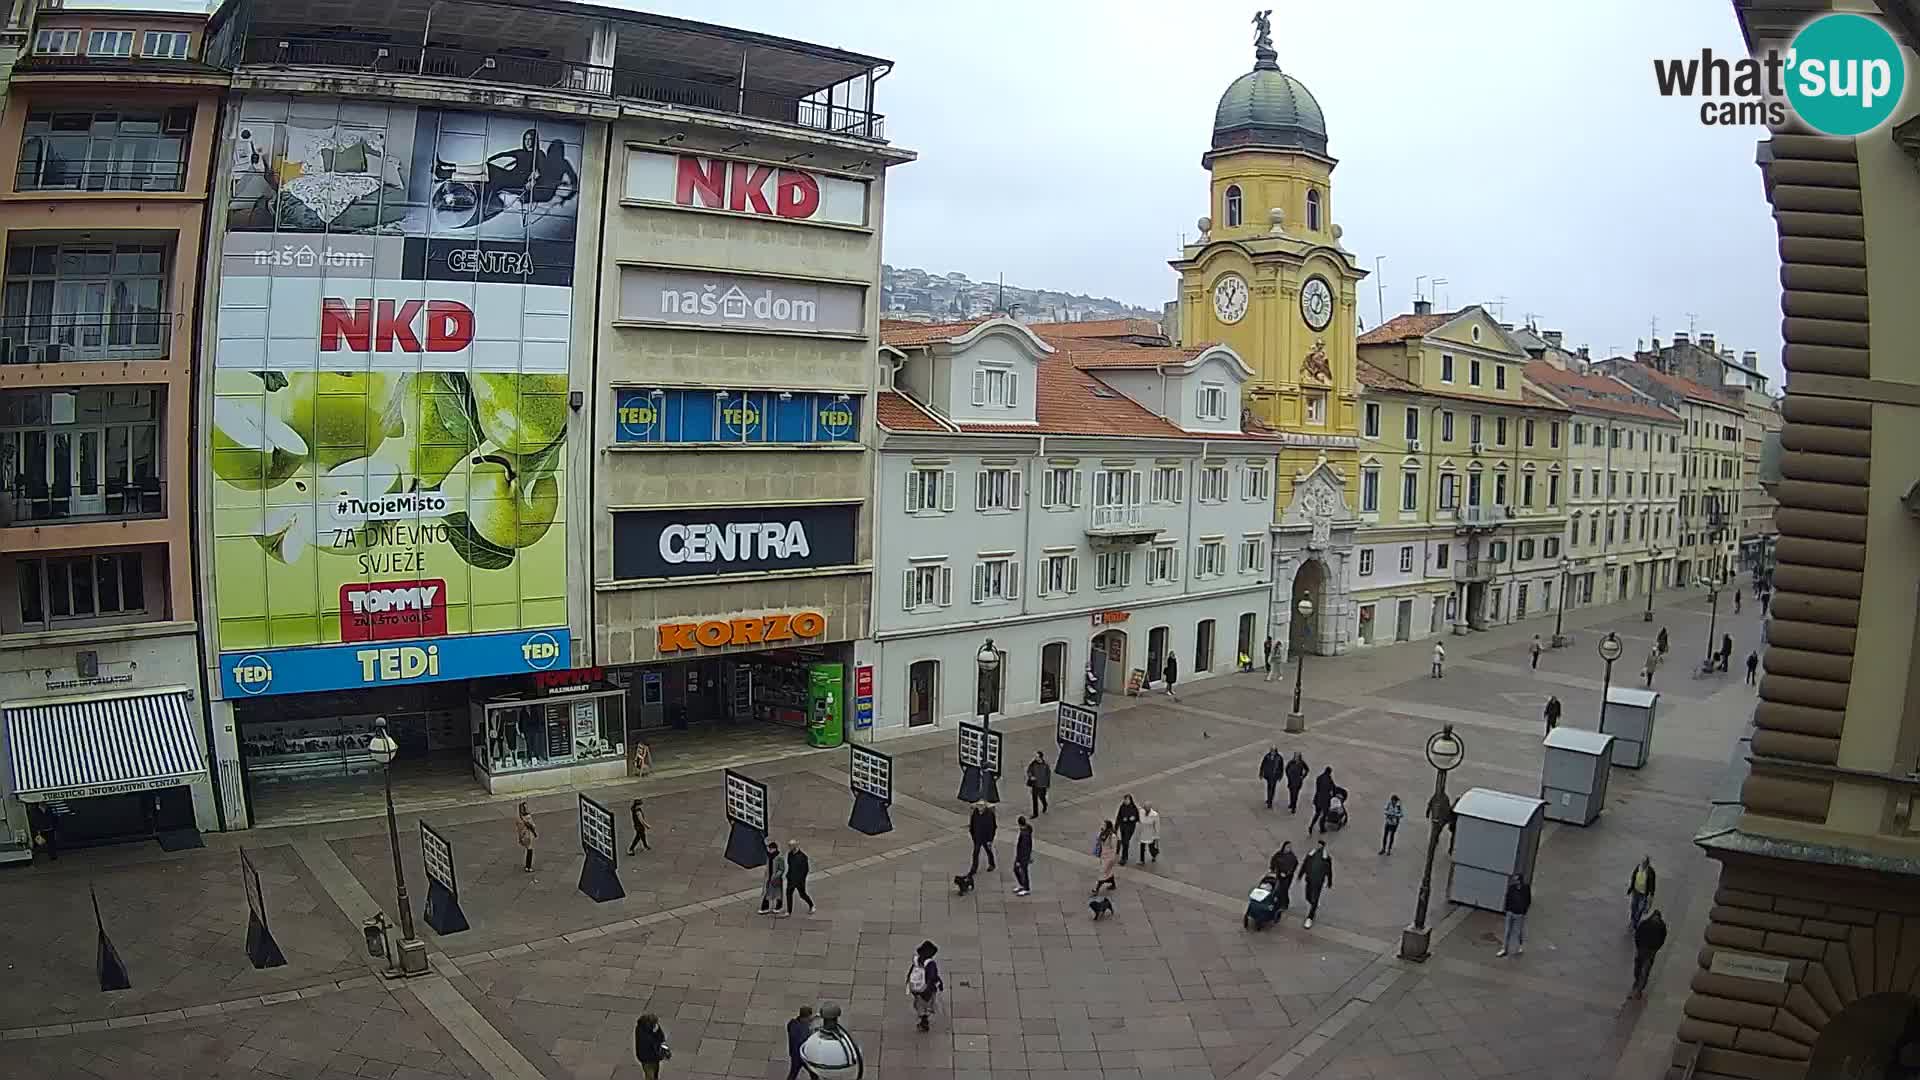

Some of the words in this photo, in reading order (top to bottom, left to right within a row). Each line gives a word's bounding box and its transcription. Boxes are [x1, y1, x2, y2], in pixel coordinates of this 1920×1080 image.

[676, 157, 821, 221] NKD
[254, 246, 293, 266] naš
[319, 246, 364, 267] dom
[447, 249, 534, 275] CENTRA
[661, 284, 716, 315] naš
[754, 290, 816, 322] dom
[321, 297, 475, 352] NKD
[619, 408, 657, 424] TEDi
[724, 408, 760, 425] TEDi
[820, 410, 853, 426] TEDi
[338, 496, 445, 515] #TvojeMisto
[332, 528, 357, 549] ZA
[365, 524, 450, 547] DNEVNO
[659, 520, 810, 564] CENTRA
[359, 547, 425, 575] SVJEŽE
[348, 586, 438, 613] TOMMY
[658, 611, 825, 652] KORZO
[357, 645, 439, 682] TEDi
[523, 643, 559, 661] TEDi
[233, 666, 272, 683] TEDi
